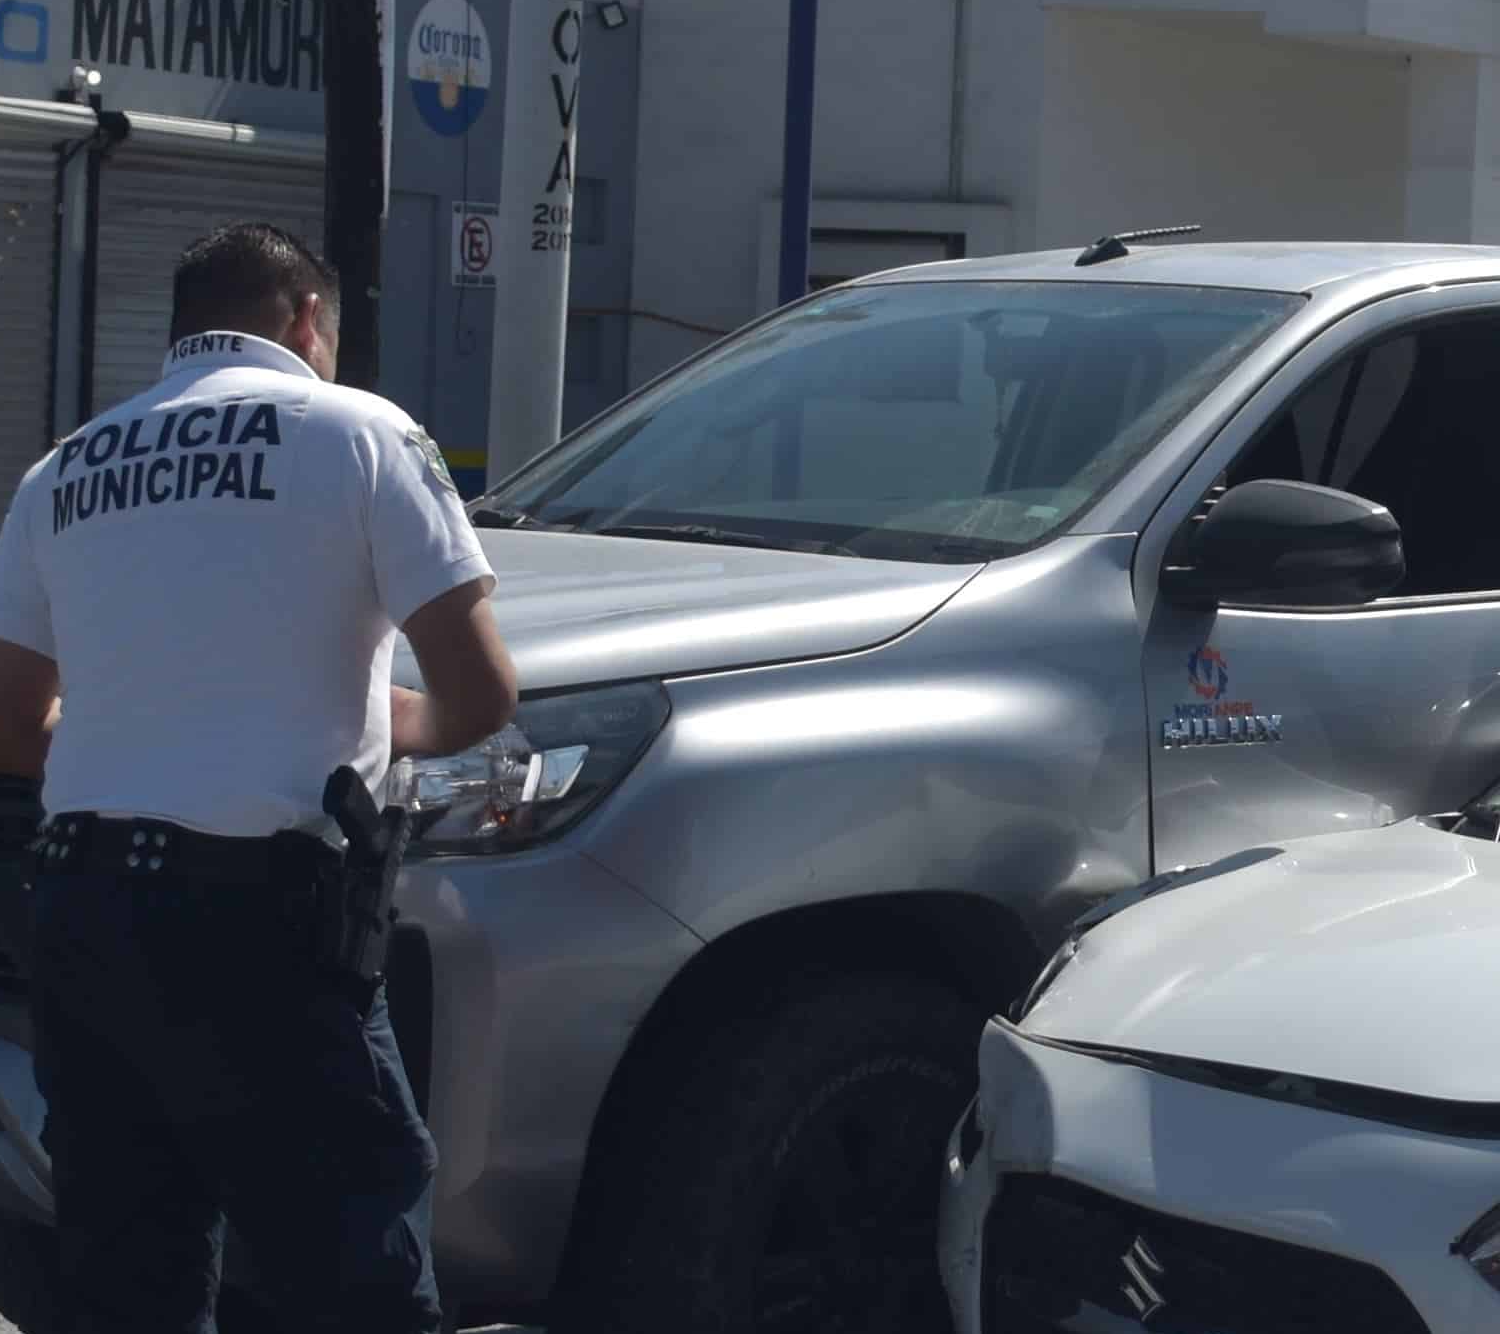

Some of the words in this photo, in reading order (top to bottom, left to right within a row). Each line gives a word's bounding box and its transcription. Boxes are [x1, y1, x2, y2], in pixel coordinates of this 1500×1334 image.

[419, 22, 485, 60] Corona
[171, 334, 245, 364] AGENTE
[56, 402, 281, 478] POLICIA
[51, 451, 276, 535] MUNICIPAL
[1162, 715, 1285, 750] HILUX
